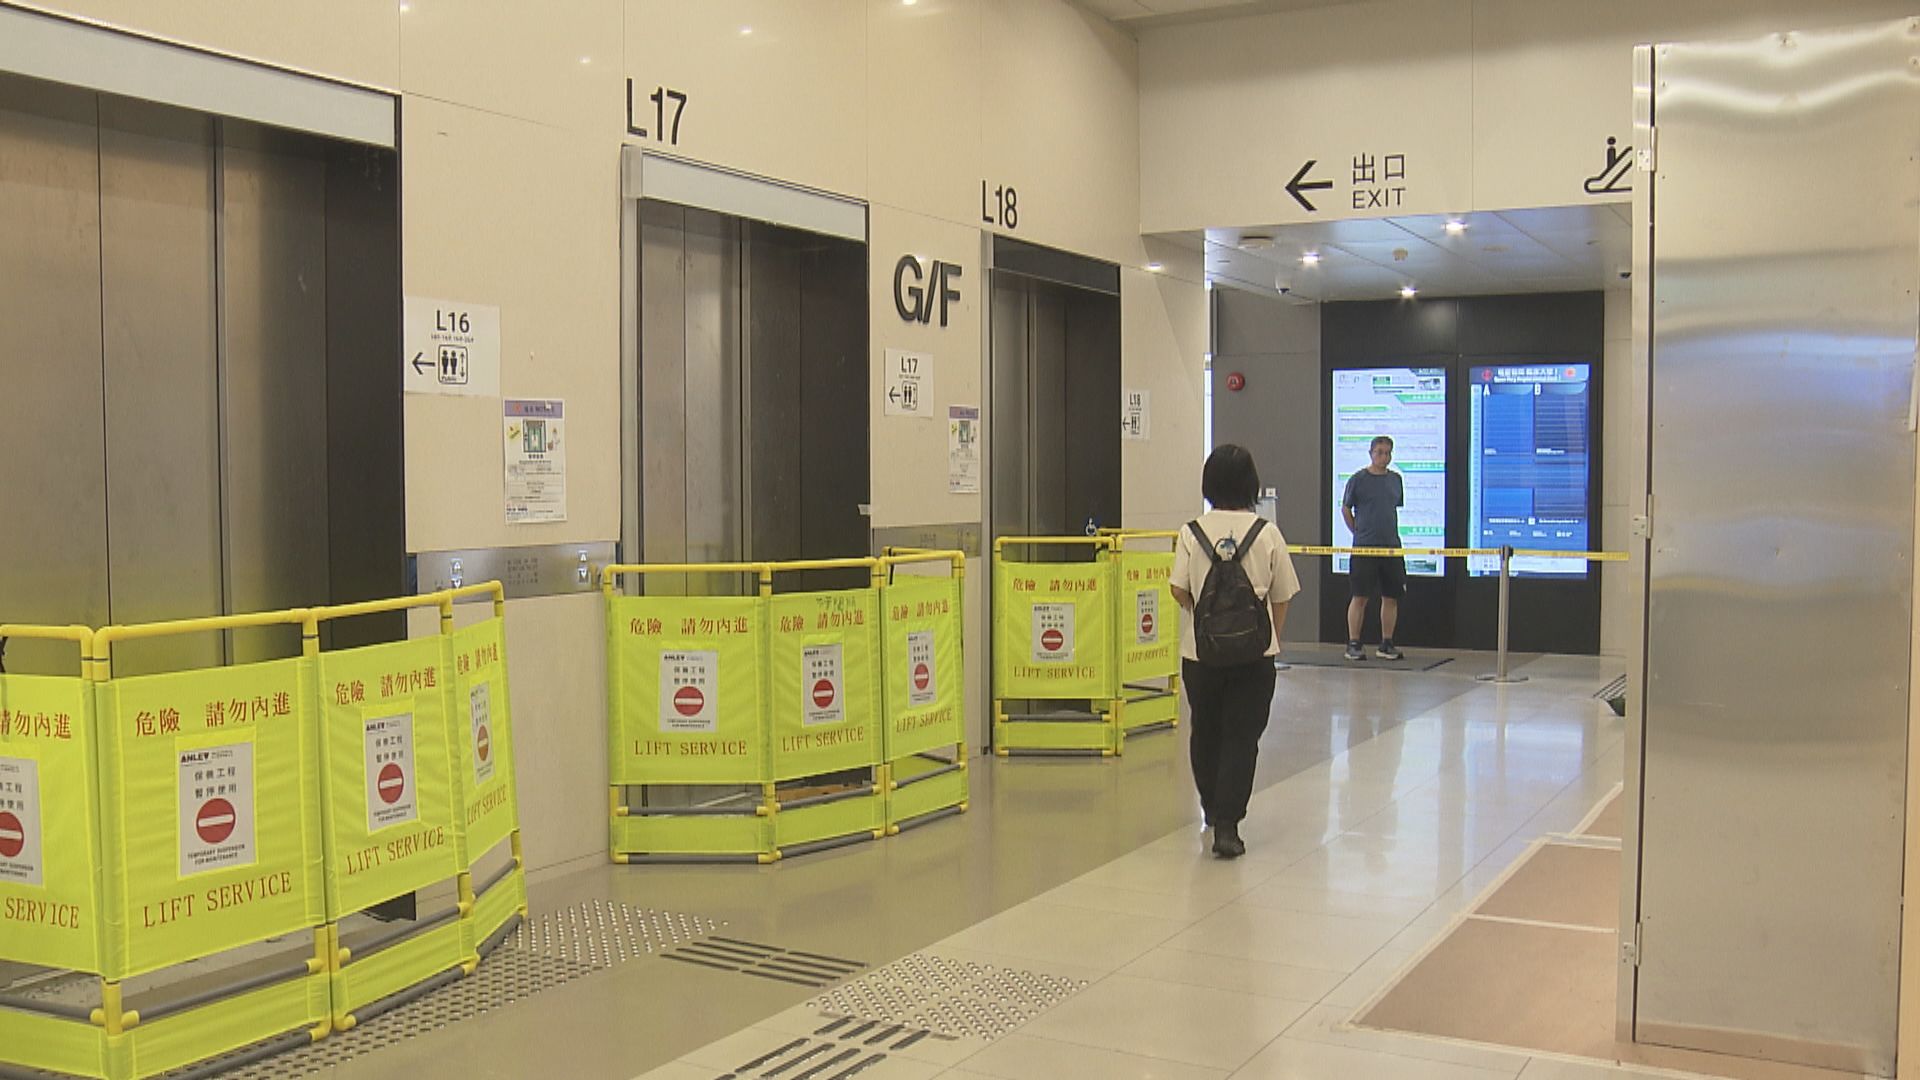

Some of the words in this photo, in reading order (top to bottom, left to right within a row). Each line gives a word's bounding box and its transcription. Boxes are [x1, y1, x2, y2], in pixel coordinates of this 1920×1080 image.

[624, 78, 687, 145] L17
[1353, 152, 1405, 185] 出口
[982, 180, 1018, 229] L18
[1353, 188, 1406, 209] EXIT
[894, 254, 963, 327] G/F
[437, 310, 470, 333] L16
[901, 356, 918, 374] L17
[630, 618, 663, 635] 危險
[682, 617, 749, 635] 請勿內進
[780, 615, 804, 632] 危險
[817, 609, 864, 629] 請勿內進
[336, 681, 365, 706] 危險
[381, 666, 437, 698] 請勿內進
[136, 708, 181, 737] 危險
[206, 692, 291, 728] 請勿內進
[635, 739, 672, 755] LIFT
[680, 741, 747, 755] SERVICE
[782, 733, 811, 752] LIFT
[816, 726, 864, 747] SERVICE
[347, 846, 381, 875] LIFT
[387, 826, 445, 861] SERVICE
[5, 897, 80, 929] SERVICE
[143, 893, 195, 928] LIFT
[207, 872, 292, 911] SERVICE
